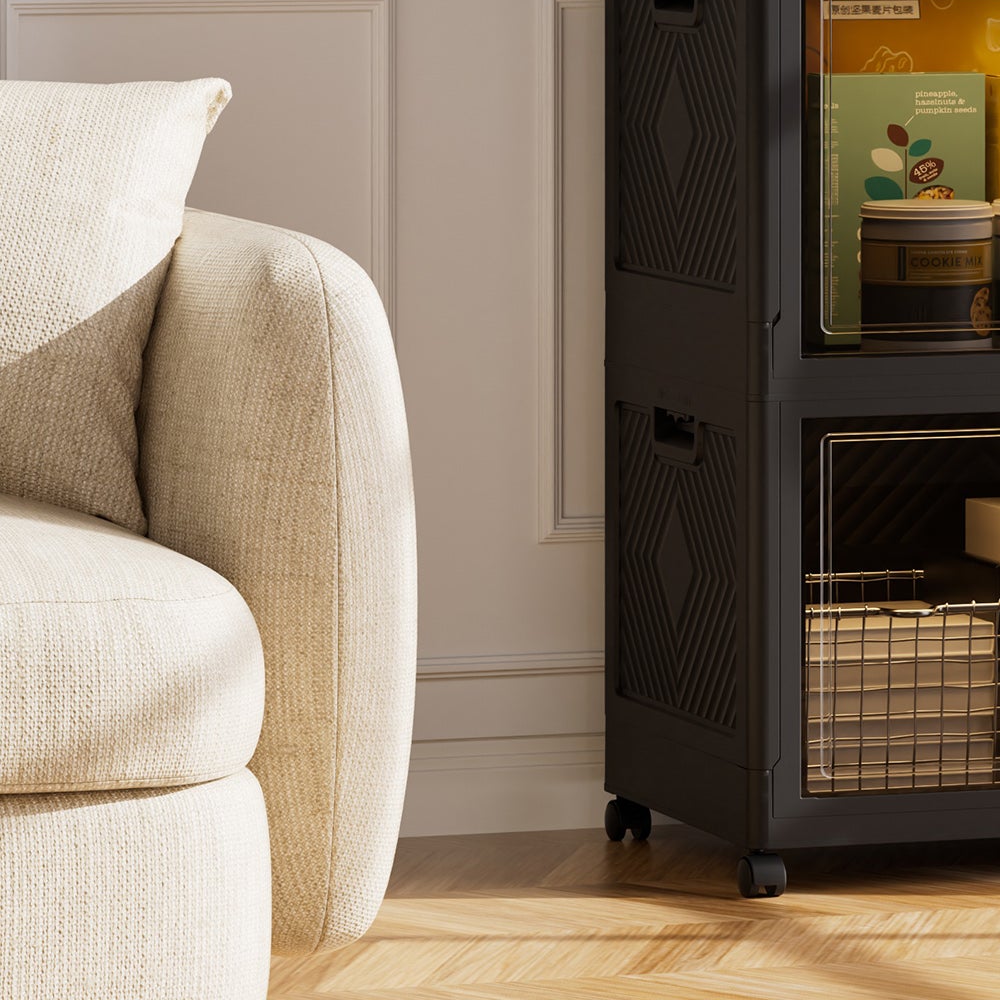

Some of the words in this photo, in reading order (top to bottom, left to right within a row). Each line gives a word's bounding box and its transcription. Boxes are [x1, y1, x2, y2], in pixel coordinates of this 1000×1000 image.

[915, 90, 958, 98] pineapple,
[915, 98, 956, 106] hazelnuts
[915, 107, 952, 115] pumpkin
[911, 257, 961, 268] COOKIE
[965, 255, 983, 267] MIX
